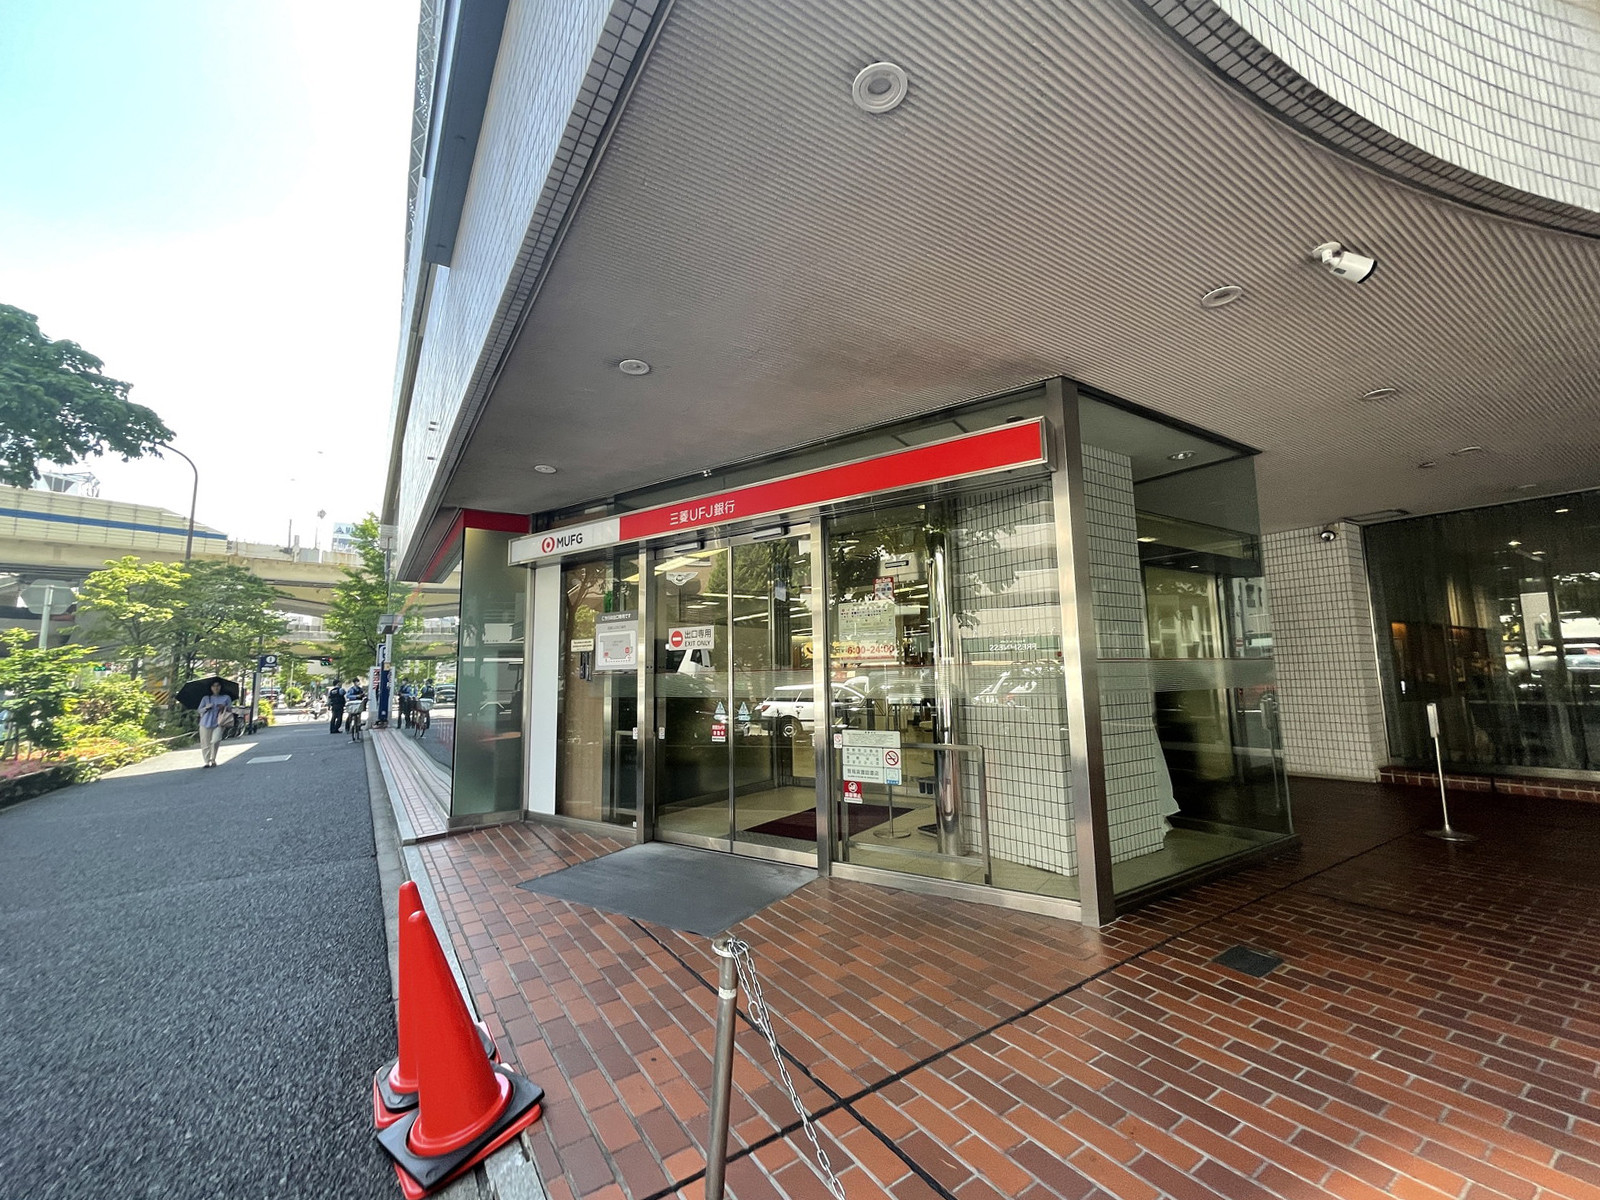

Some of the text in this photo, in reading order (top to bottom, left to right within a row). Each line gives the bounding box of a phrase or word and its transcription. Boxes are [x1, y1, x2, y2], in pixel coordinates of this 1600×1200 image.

[669, 499, 735, 525] 三菱UFJ銀行
[556, 532, 584, 549] MUFG
[684, 628, 712, 639] 出口専用
[684, 640, 696, 648] EXIT
